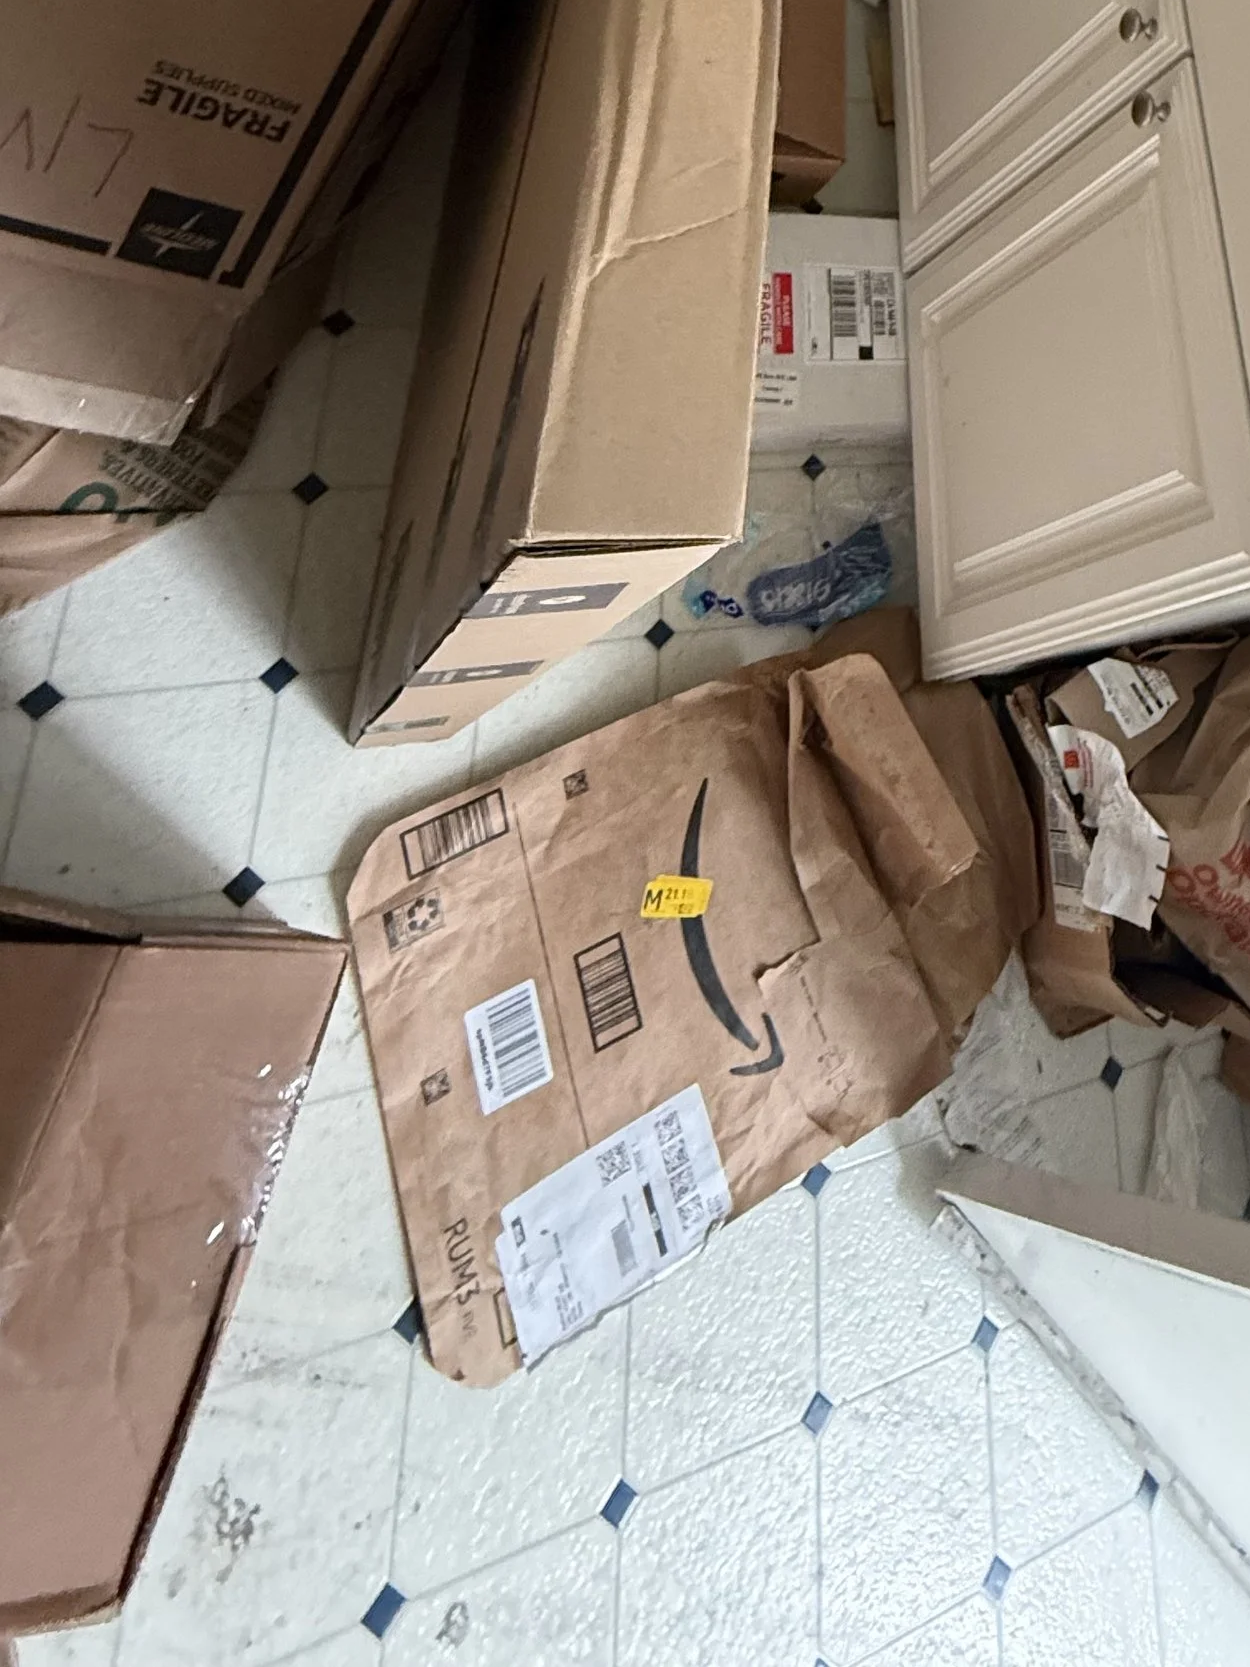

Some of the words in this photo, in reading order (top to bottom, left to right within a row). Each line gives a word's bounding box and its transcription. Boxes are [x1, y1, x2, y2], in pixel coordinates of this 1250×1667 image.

[153, 59, 241, 99] SUPPLIES
[244, 87, 303, 115] MIXED
[138, 78, 293, 143] FRAGILE
[761, 283, 771, 345] FRAGILE
[643, 888, 663, 911] M
[443, 1218, 482, 1305] RUM3
